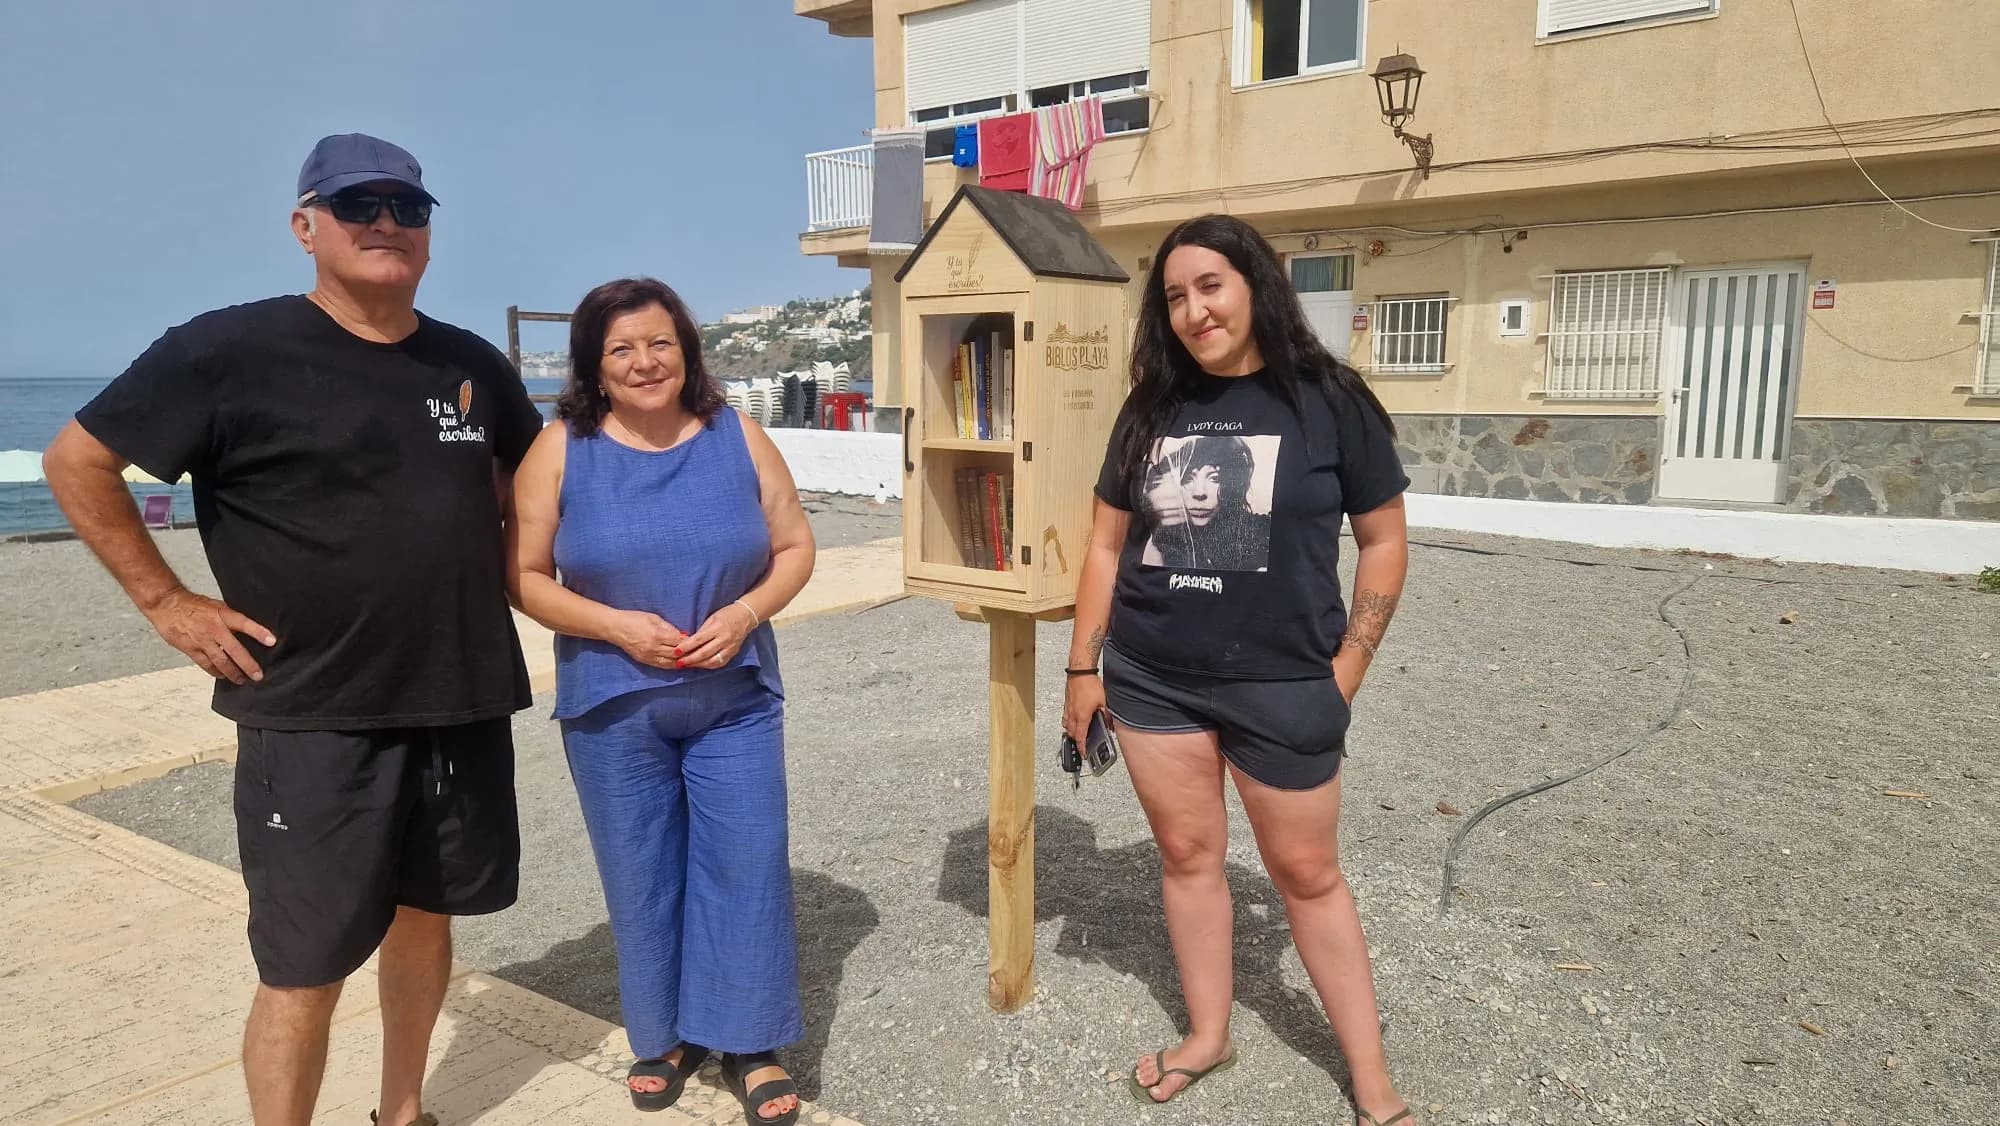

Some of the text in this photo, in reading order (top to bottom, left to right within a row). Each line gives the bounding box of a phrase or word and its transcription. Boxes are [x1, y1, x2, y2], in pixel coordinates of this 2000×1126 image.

[948, 274, 984, 289] escribes?
[426, 398, 456, 418] Y tú
[439, 415, 459, 431] qué
[1214, 421, 1243, 431] GAGA
[438, 424, 486, 442] escribes?
[1169, 573, 1223, 595] MAYHEM
